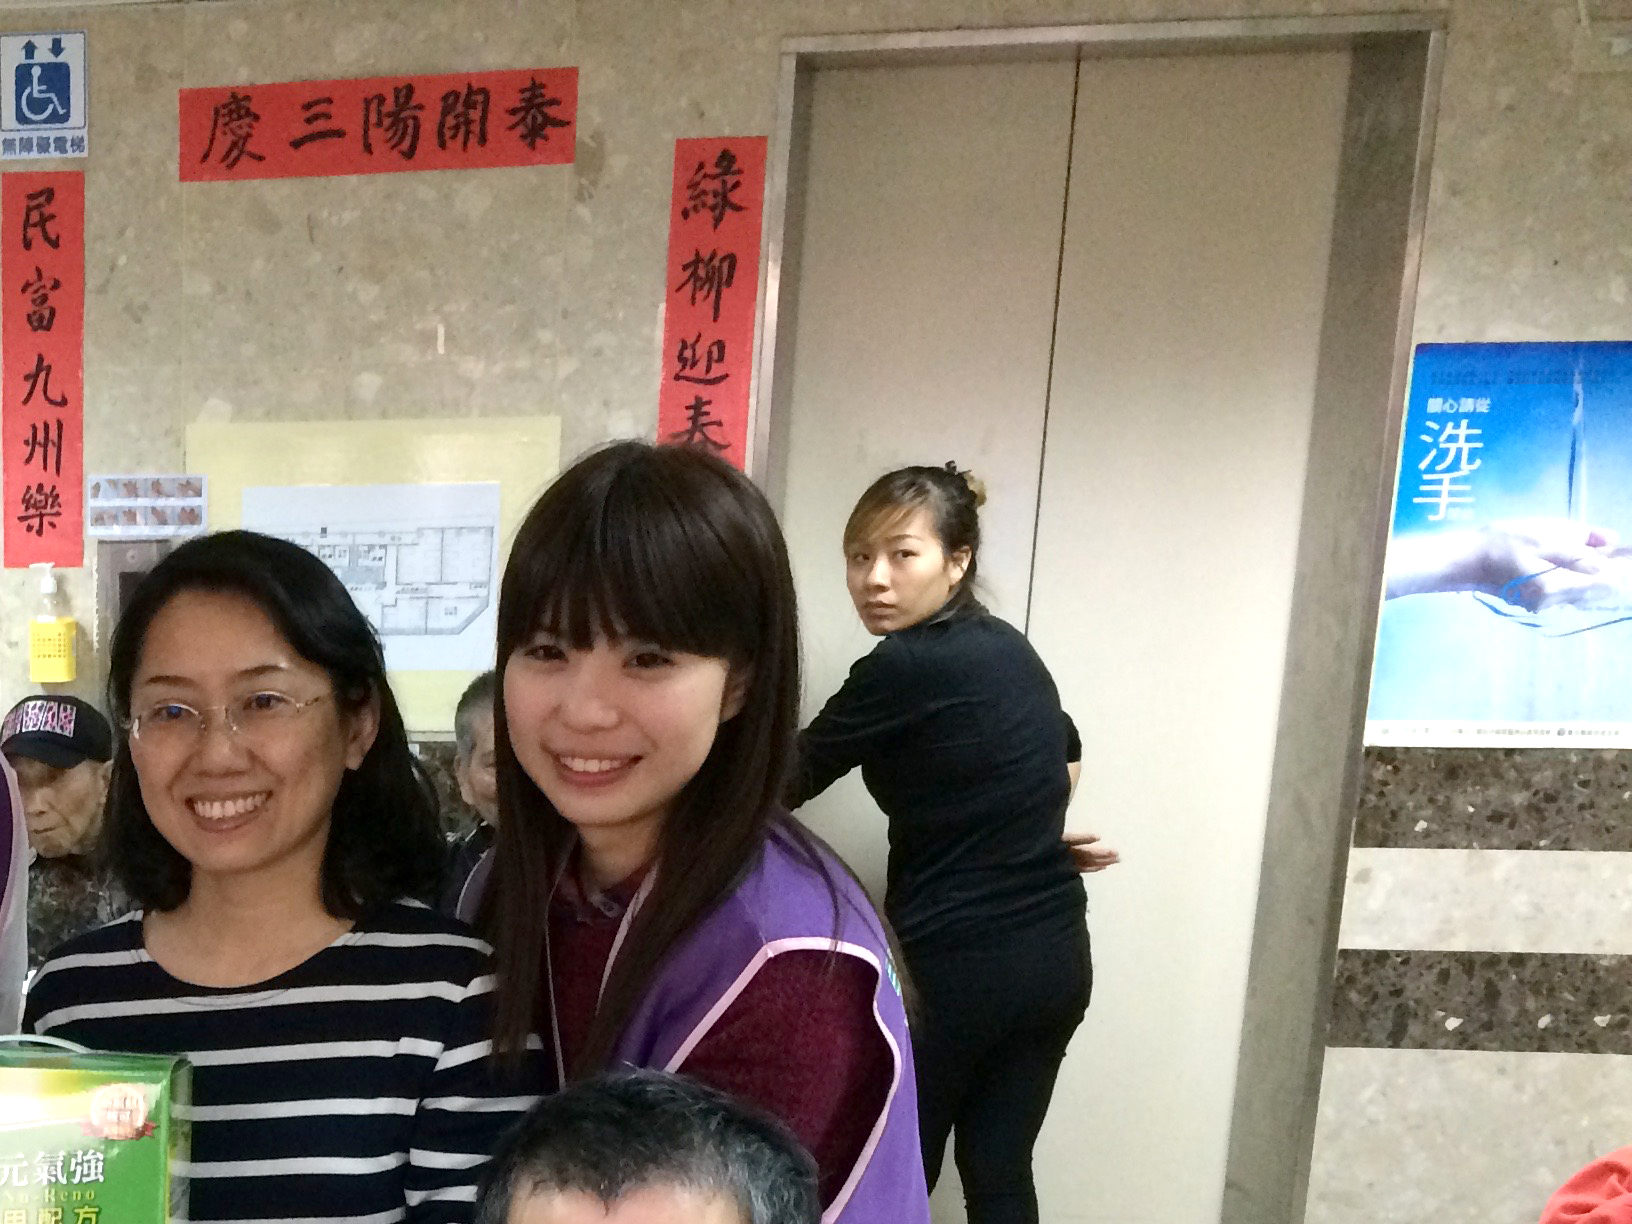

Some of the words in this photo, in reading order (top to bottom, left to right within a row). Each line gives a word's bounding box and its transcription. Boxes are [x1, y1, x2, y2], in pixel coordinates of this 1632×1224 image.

[200, 76, 572, 170] 慶三陽開泰
[17, 186, 68, 538] 民富九州樂
[1412, 418, 1485, 521] 洗手
